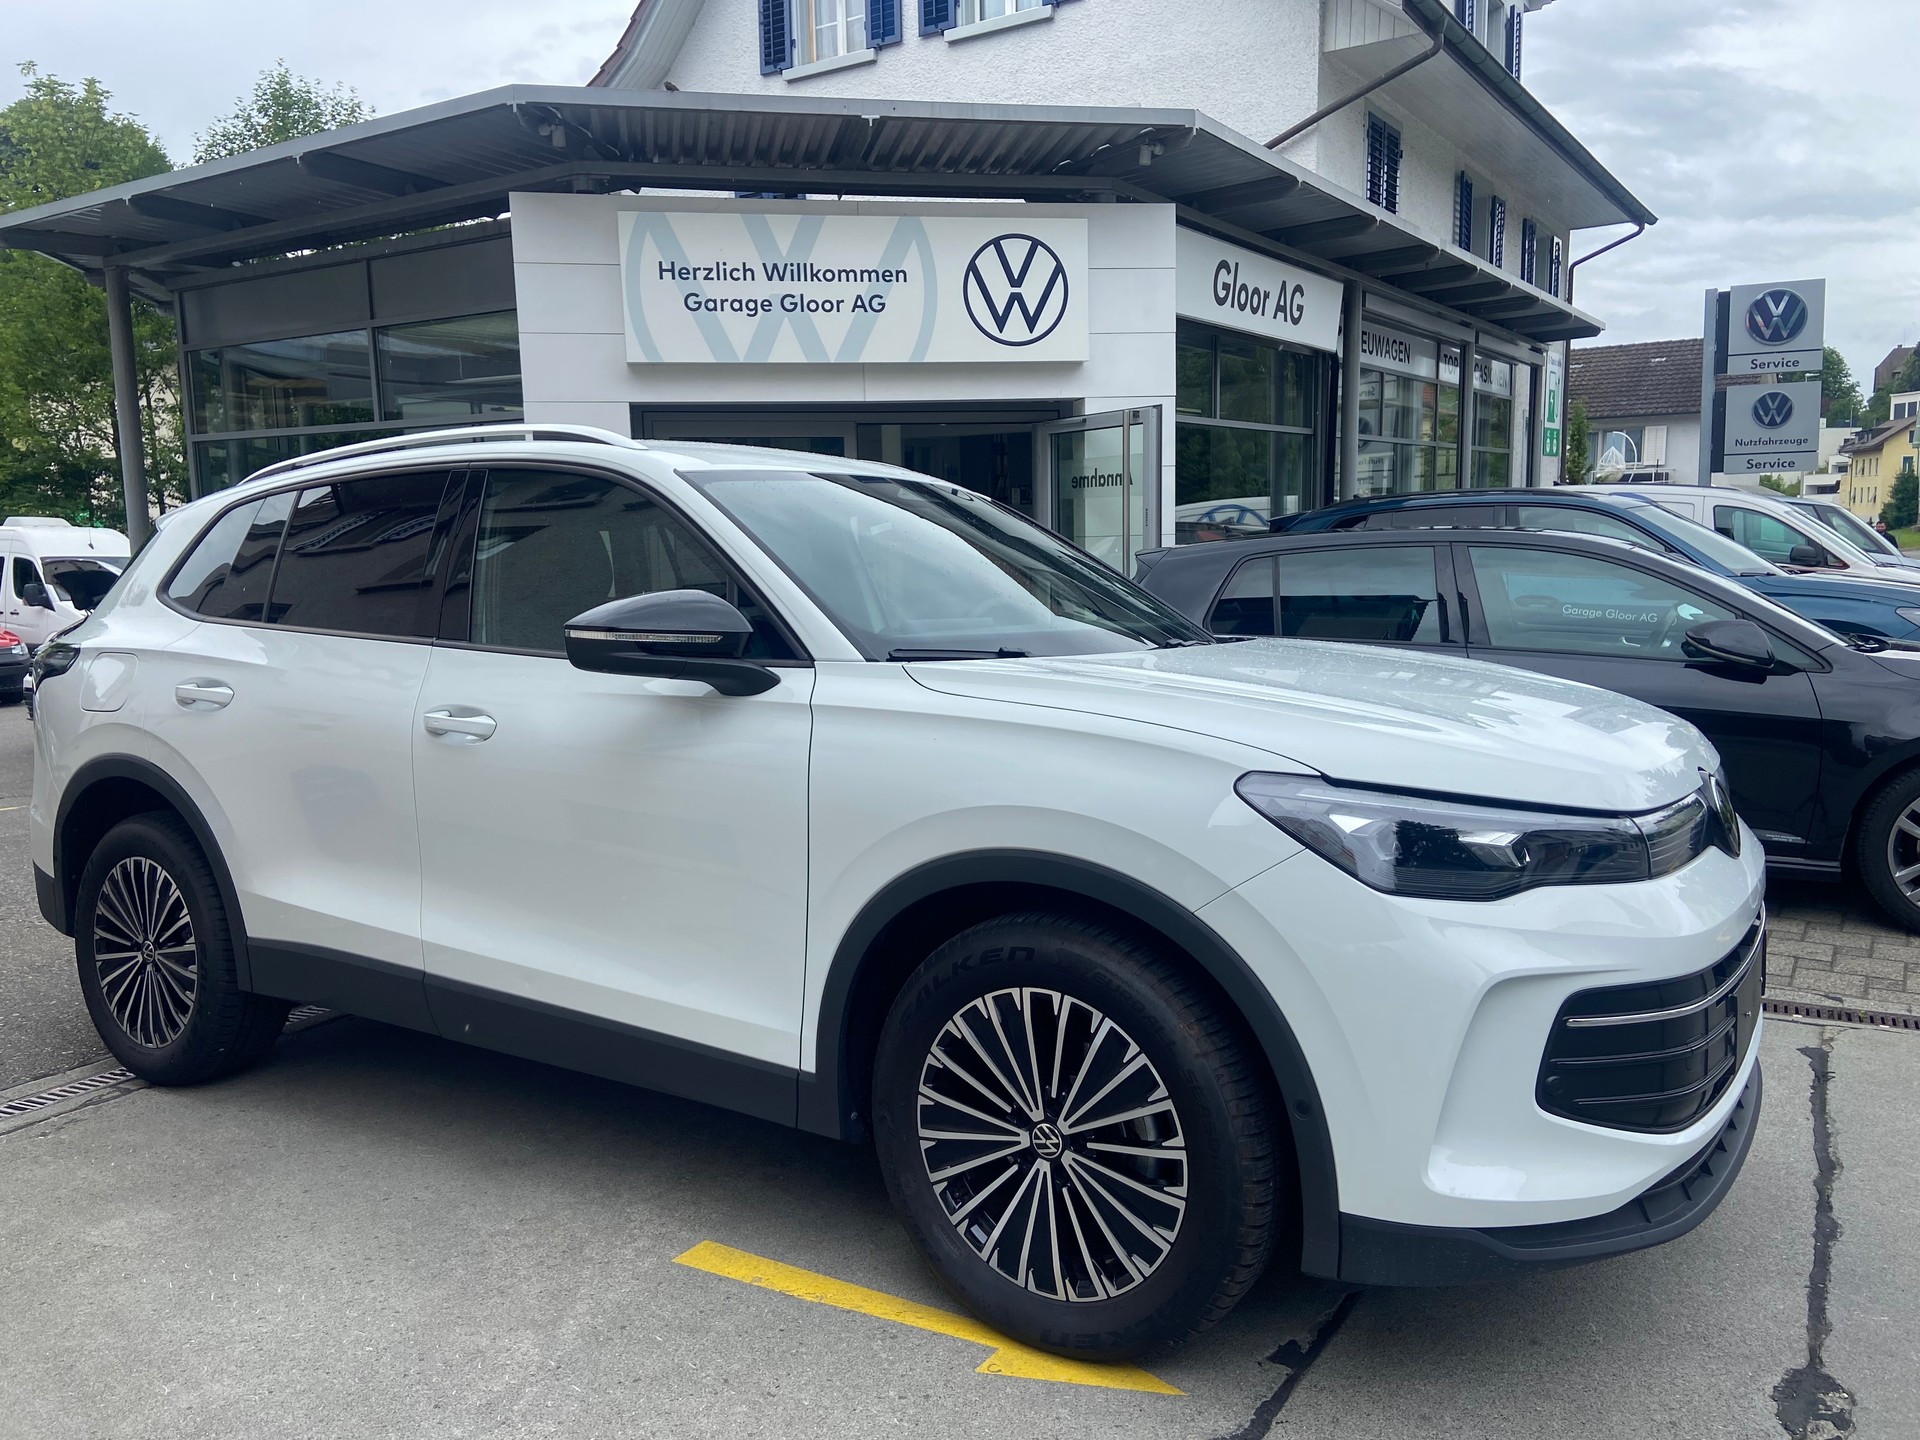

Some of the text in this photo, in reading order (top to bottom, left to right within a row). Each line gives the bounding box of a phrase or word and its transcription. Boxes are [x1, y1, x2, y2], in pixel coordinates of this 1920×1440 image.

[658, 261, 908, 283] Herzlich Willkommen
[1213, 259, 1305, 325] Gloor AG
[683, 292, 887, 317] Garage Gloor AG
[1361, 330, 1411, 364] EUWAGEN
[1443, 353, 1459, 376] TOP
[1750, 357, 1800, 370] Service
[1735, 437, 1809, 447] Nutzfahrzeuge
[1746, 459, 1796, 470] Service
[1562, 604, 1602, 619] Garage
[1606, 609, 1637, 621] Gloor
[1639, 612, 1658, 623] AG
